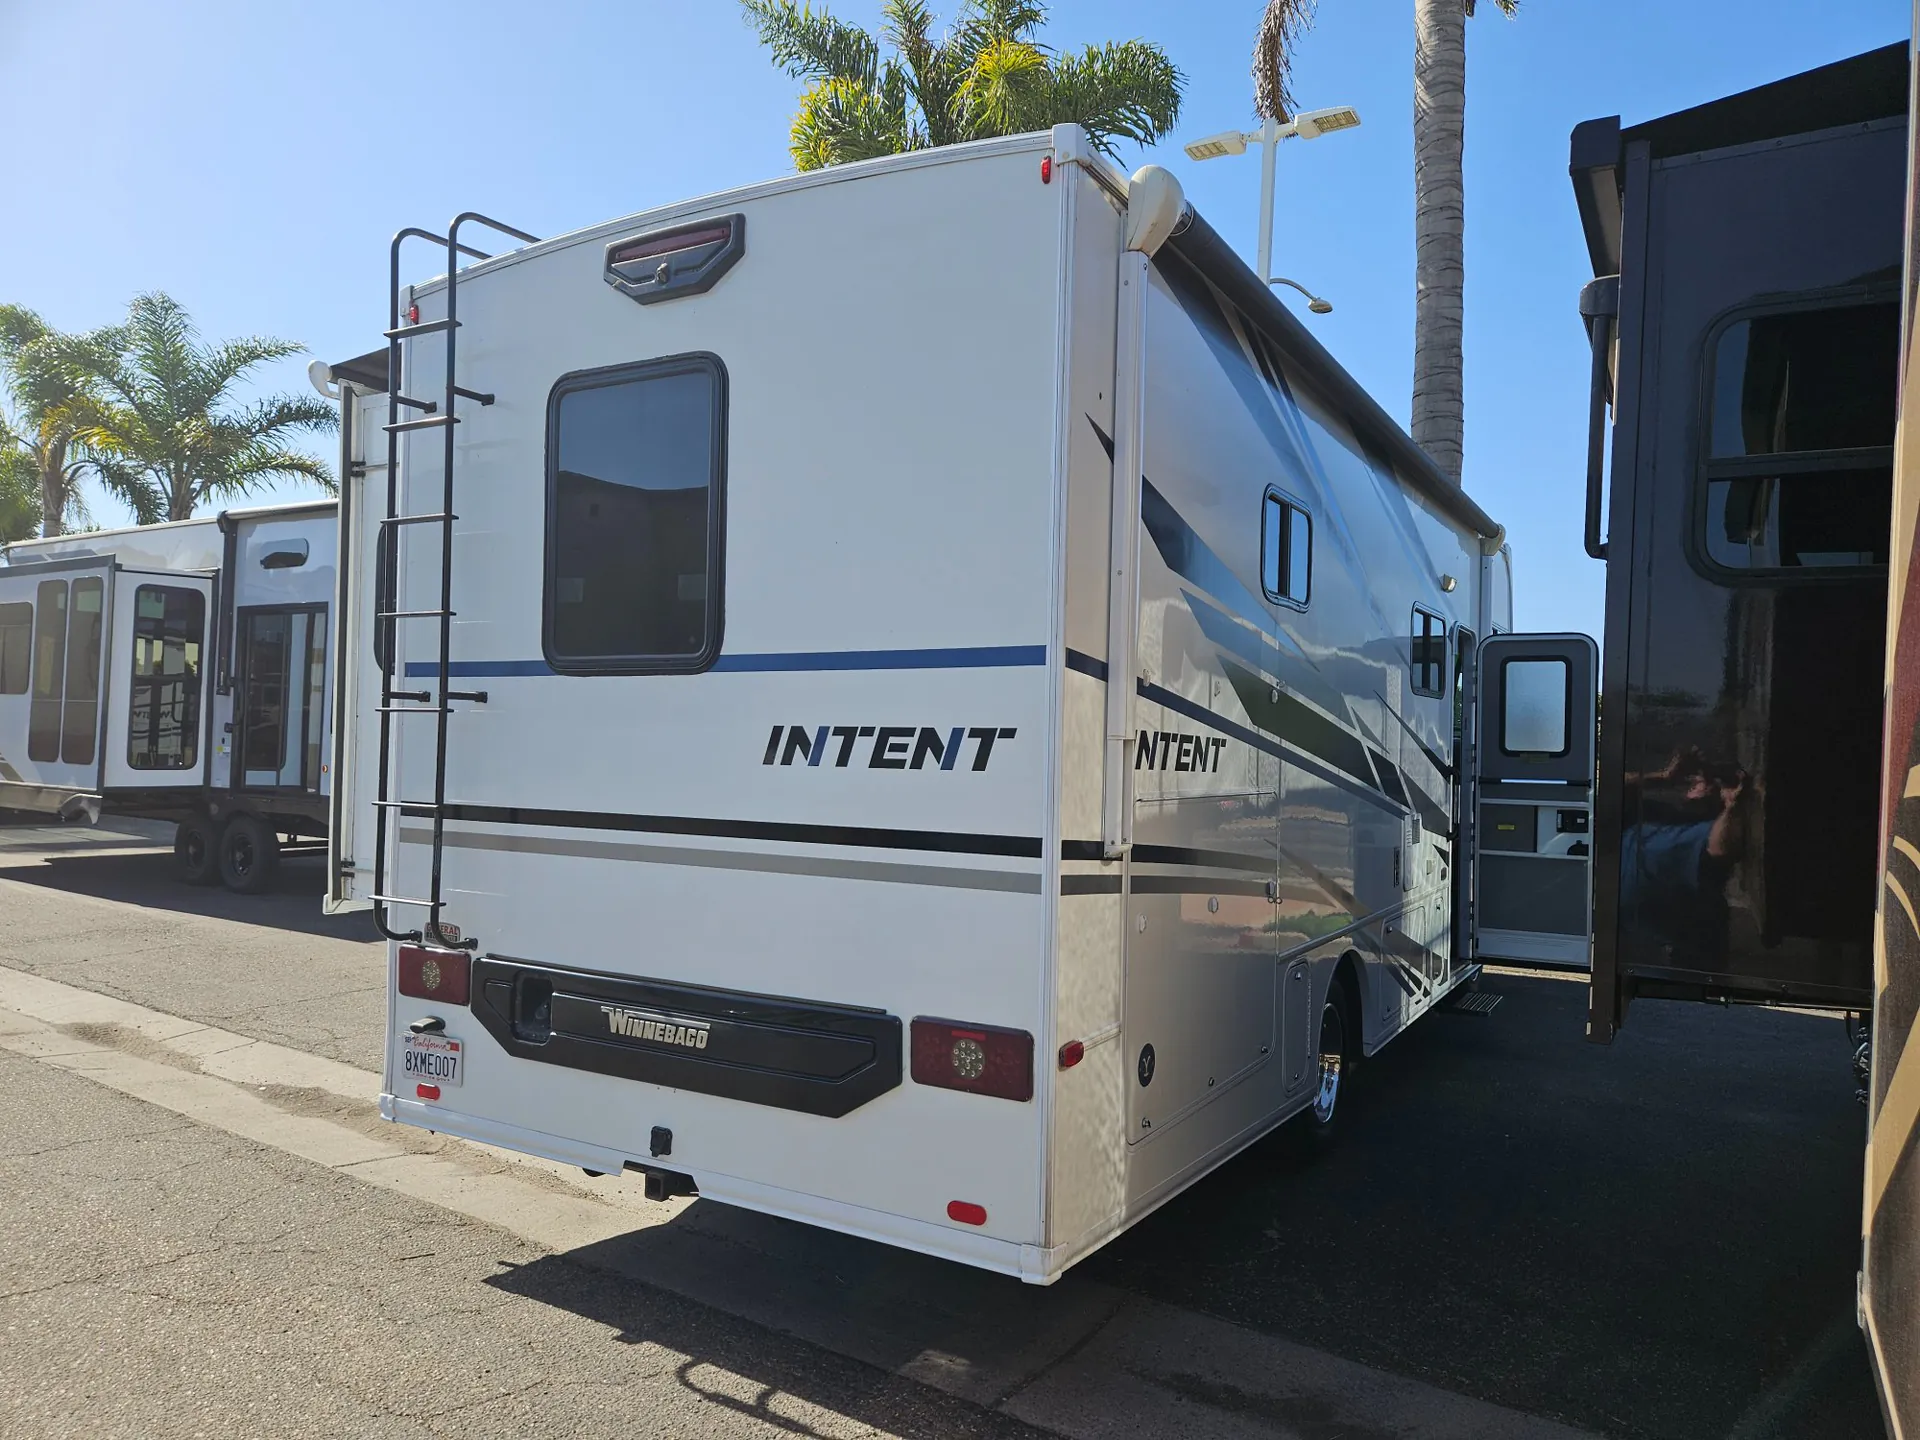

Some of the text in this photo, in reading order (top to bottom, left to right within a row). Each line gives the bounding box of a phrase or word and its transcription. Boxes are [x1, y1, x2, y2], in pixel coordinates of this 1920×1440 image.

[762, 725, 1018, 772] INTENT
[1135, 730, 1227, 773] NTENT
[601, 1005, 711, 1049] WINNEBAGO
[405, 1050, 457, 1079] 8XME007
